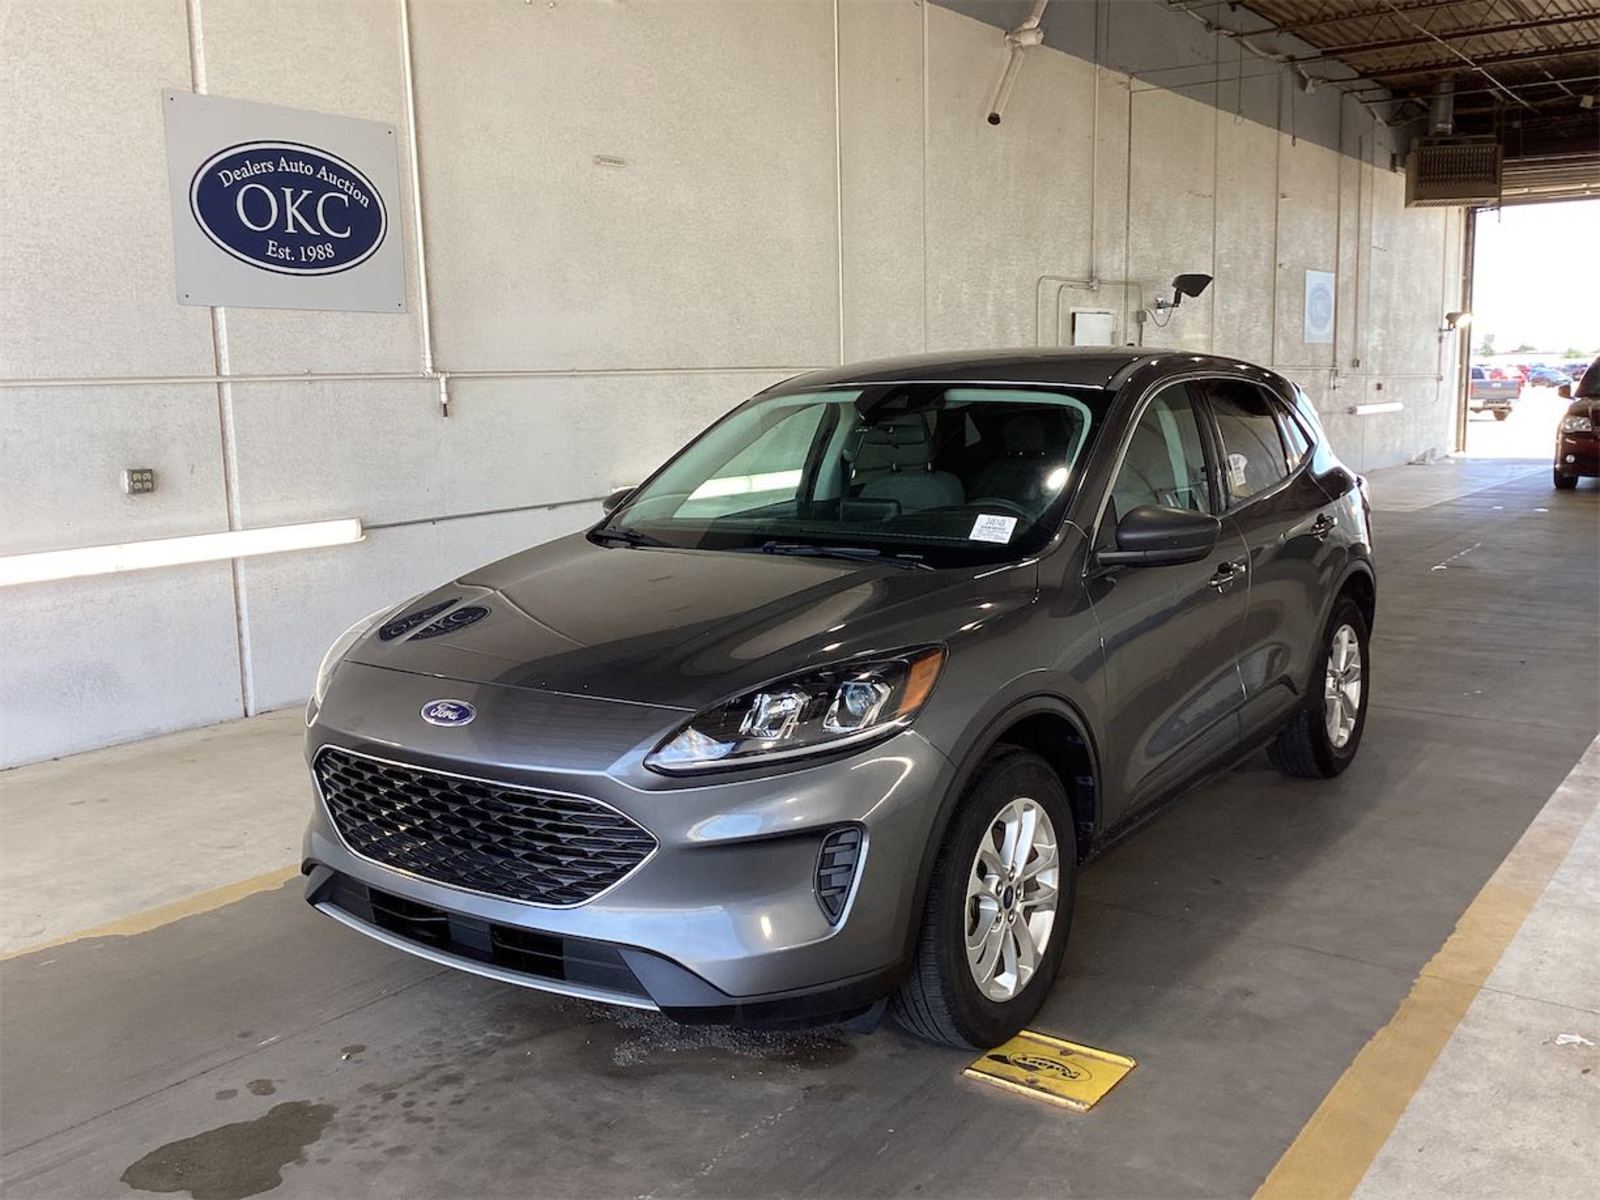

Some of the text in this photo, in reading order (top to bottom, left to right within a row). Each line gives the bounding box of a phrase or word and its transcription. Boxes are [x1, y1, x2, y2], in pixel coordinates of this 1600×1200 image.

[217, 156, 370, 208] Dealers Auto Auction
[236, 183, 352, 239] OKC
[265, 239, 336, 263] Est. 1988
[429, 701, 464, 720] Ford
